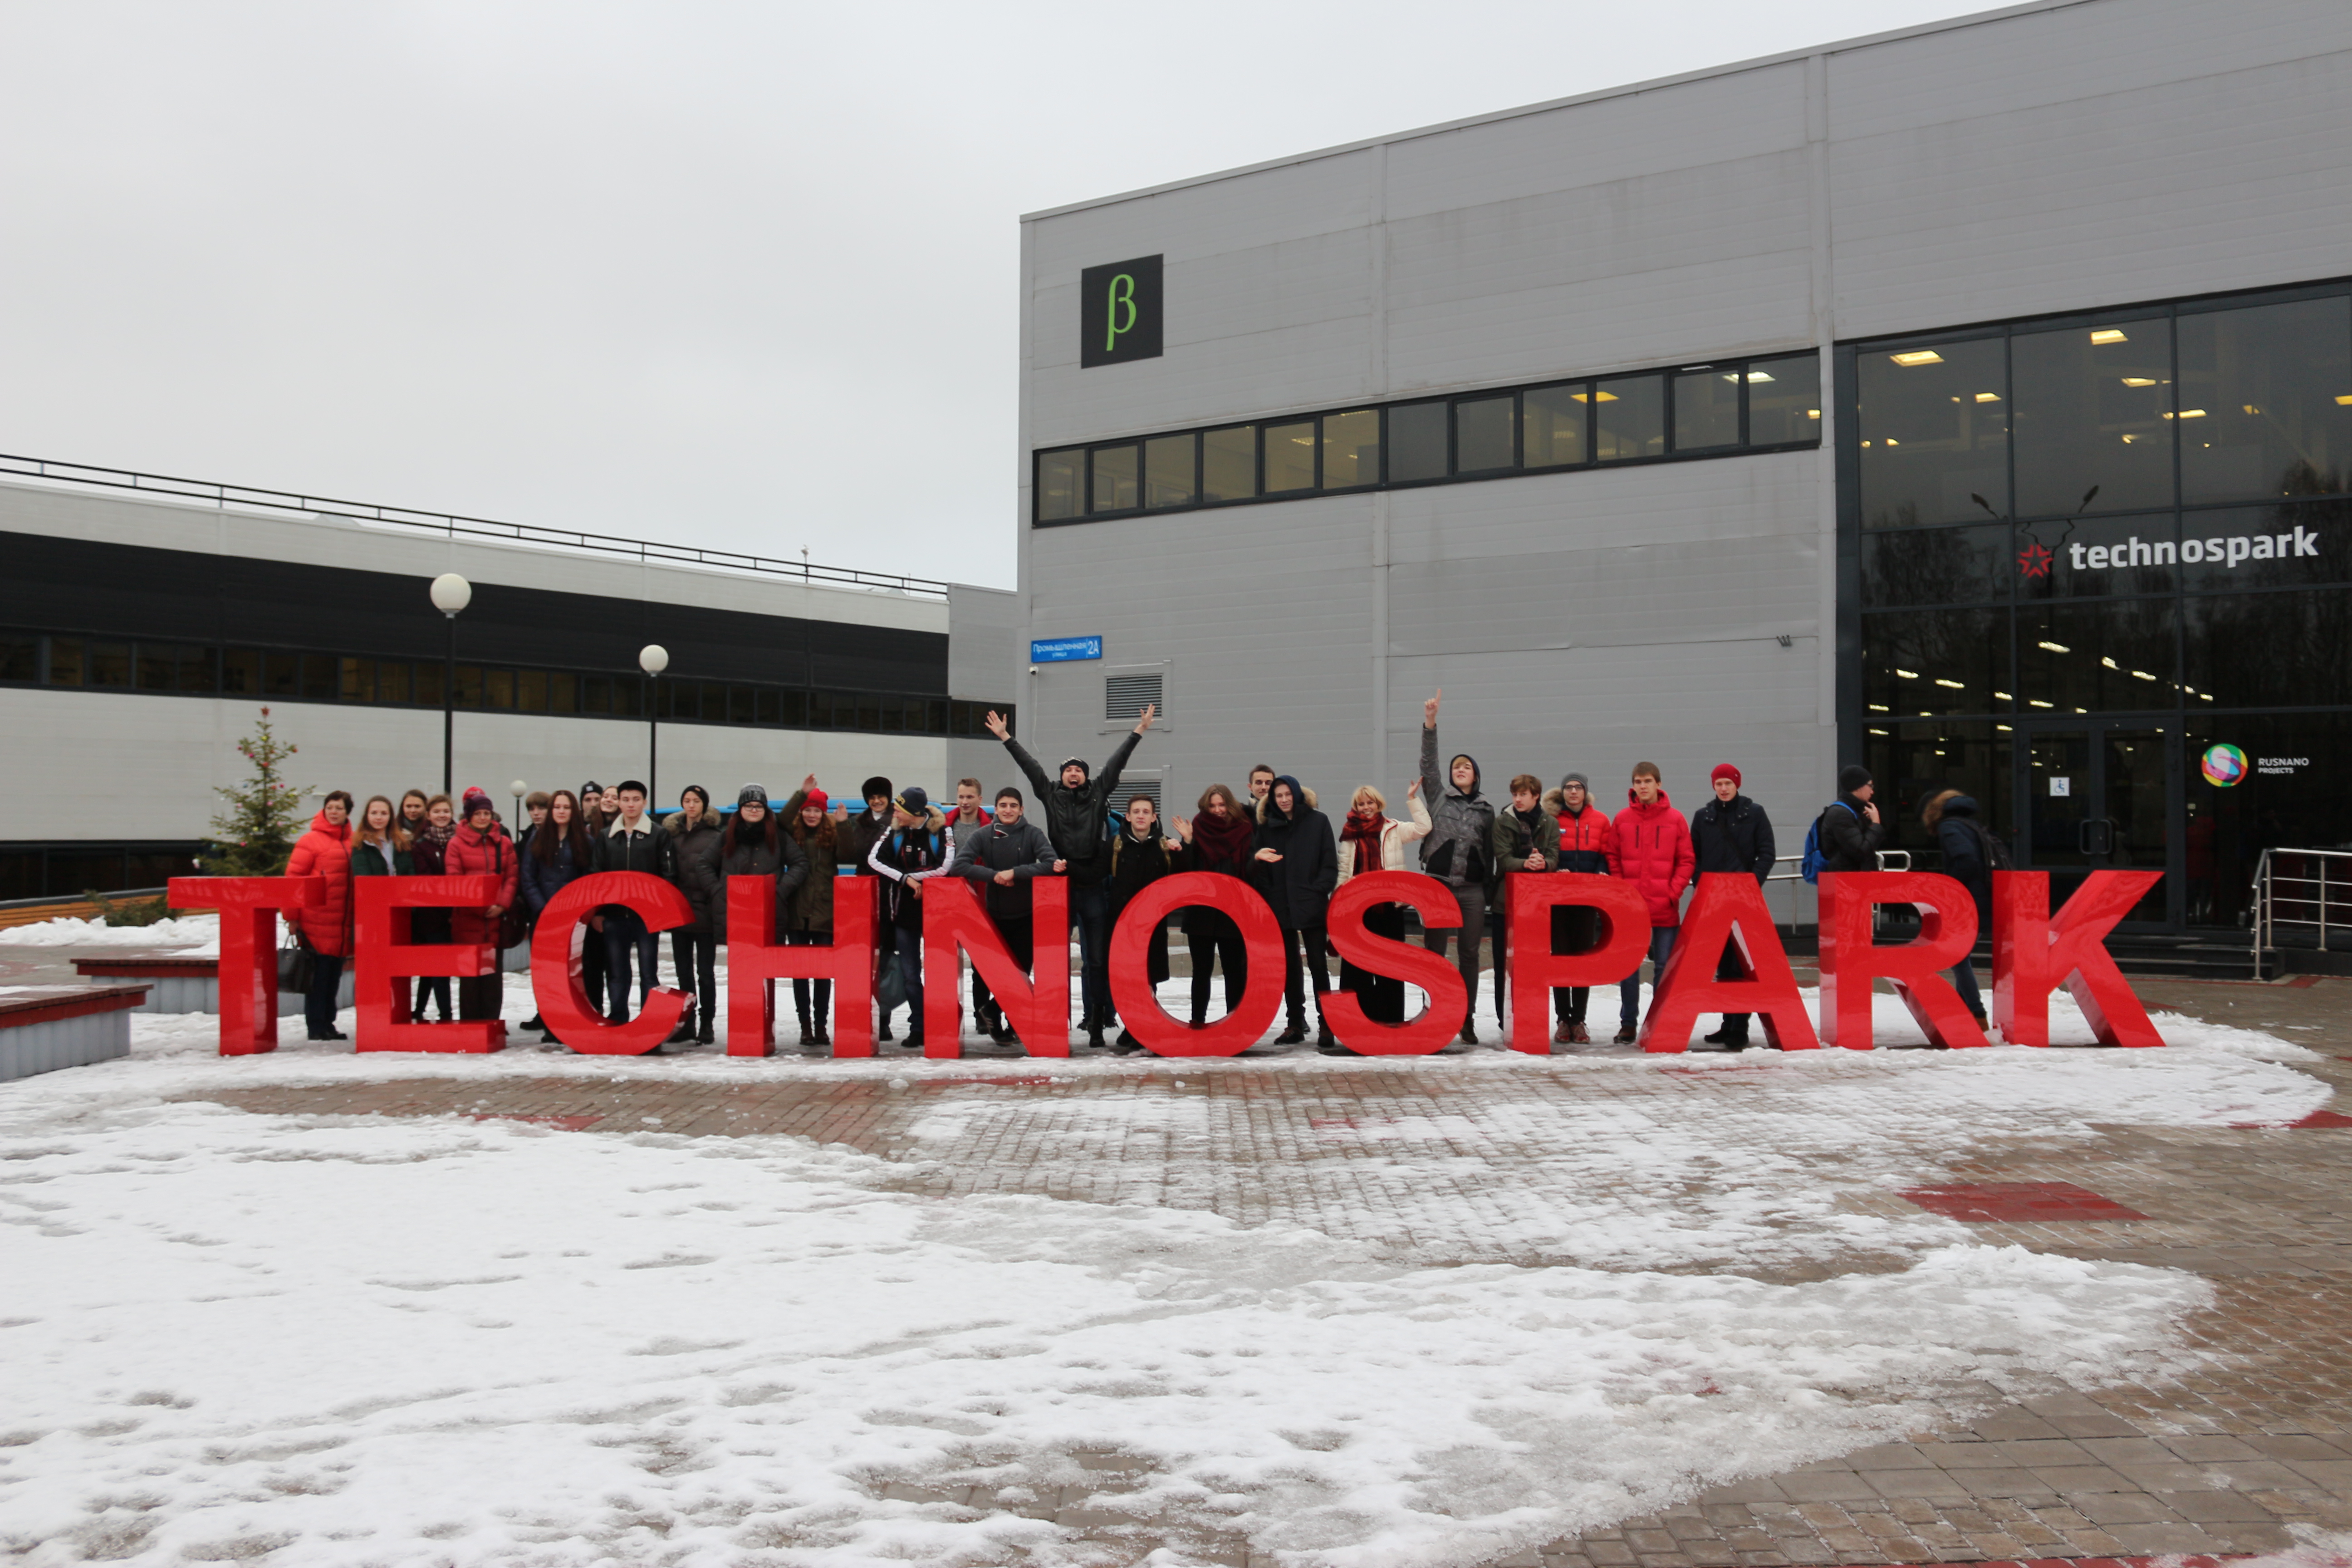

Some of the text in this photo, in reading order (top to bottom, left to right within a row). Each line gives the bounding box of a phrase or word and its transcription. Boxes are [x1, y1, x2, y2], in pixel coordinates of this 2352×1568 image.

[2069, 525, 2319, 570] technospark
[2258, 758, 2309, 766] RUSNANO
[167, 869, 2167, 1058] TECHNOSPARK
